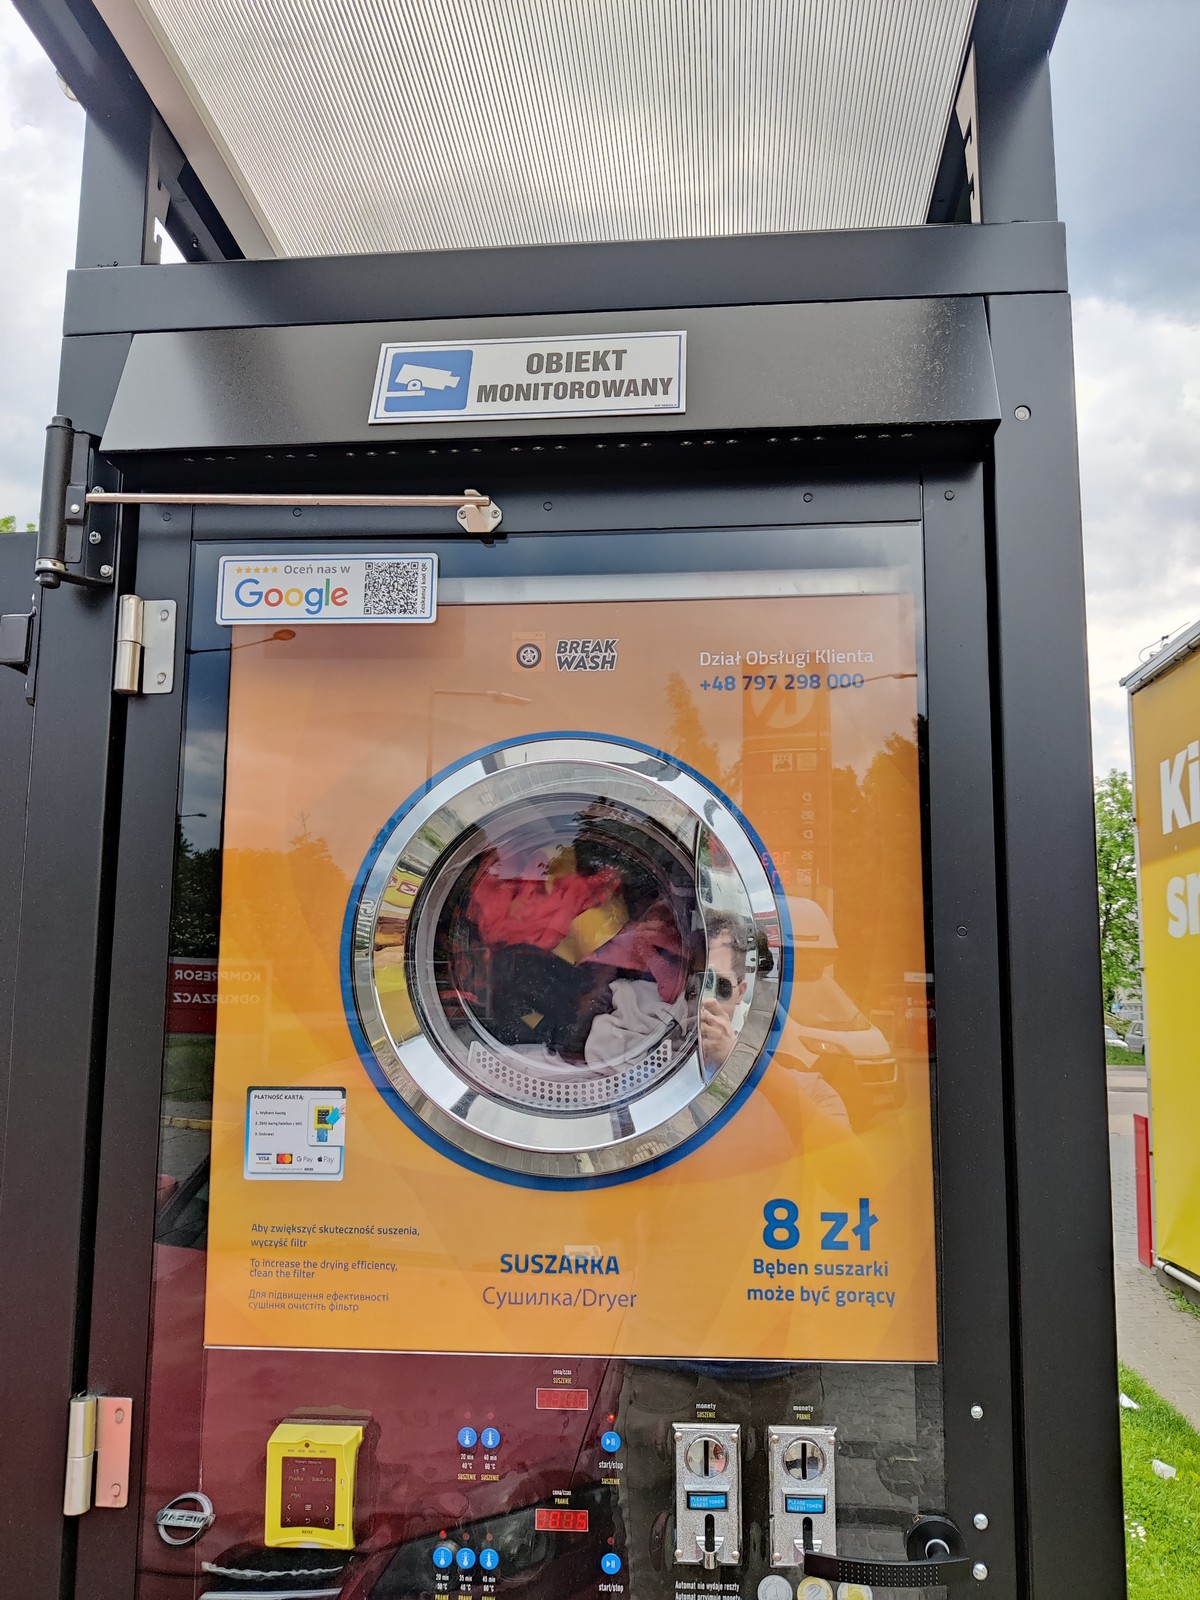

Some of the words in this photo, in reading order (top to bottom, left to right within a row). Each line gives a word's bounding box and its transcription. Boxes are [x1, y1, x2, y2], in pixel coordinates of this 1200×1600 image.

[526, 349, 627, 375] OBIEKT
[476, 377, 673, 403] MONITOROWANY
[284, 564, 313, 574] Oceń
[316, 566, 337, 574] nas
[421, 562, 428, 572] QR
[234, 578, 348, 615] Google
[556, 639, 618, 654] BREAK
[556, 654, 616, 670] WASH
[700, 651, 742, 666] Dział
[746, 650, 810, 668] Obsługi
[815, 649, 874, 664] Klienta
[700, 676, 736, 692] +48
[742, 674, 778, 690] 797
[784, 674, 821, 690] 298
[826, 672, 865, 690] 000
[324, 1156, 334, 1164] Pay
[251, 1224, 268, 1234] Aby
[270, 1224, 316, 1236] zwiększyć
[319, 1225, 375, 1235] skuteczność
[377, 1226, 420, 1236] suszenia,
[762, 1198, 800, 1250] 8
[820, 1198, 879, 1251] zł
[251, 1238, 288, 1249] wyczyść
[290, 1238, 307, 1248] filtr
[250, 1258, 260, 1268] To
[262, 1259, 300, 1268] increase
[303, 1260, 318, 1269] the
[320, 1260, 349, 1271] drying
[351, 1261, 398, 1272] efficiency,
[500, 1253, 620, 1275] SUSZARKA
[753, 1258, 808, 1278] Bęben
[814, 1261, 888, 1276] suszarki
[250, 1269, 272, 1278] clean
[276, 1269, 290, 1278] the
[293, 1269, 315, 1278] filter
[248, 1290, 266, 1300] Для
[269, 1290, 324, 1301] підвищення
[326, 1292, 389, 1302] ефективності
[482, 1286, 637, 1312] Сушилка/Dryer
[747, 1285, 795, 1301] może
[800, 1286, 830, 1306] być
[836, 1290, 896, 1308] gorący
[248, 1301, 285, 1311] сушіння
[288, 1302, 326, 1311] очистіть
[328, 1302, 359, 1312] фільтр
[793, 1404, 814, 1412] monety
[598, 1461, 624, 1470] start/stop
[598, 1582, 624, 1594] start/stop
[675, 1580, 696, 1590] Automat
[697, 1581, 705, 1590] nie
[706, 1581, 723, 1592] wydaje
[724, 1582, 740, 1592] reszty
[806, 1584, 822, 1600] 2
[675, 1592, 696, 1600] Automat
